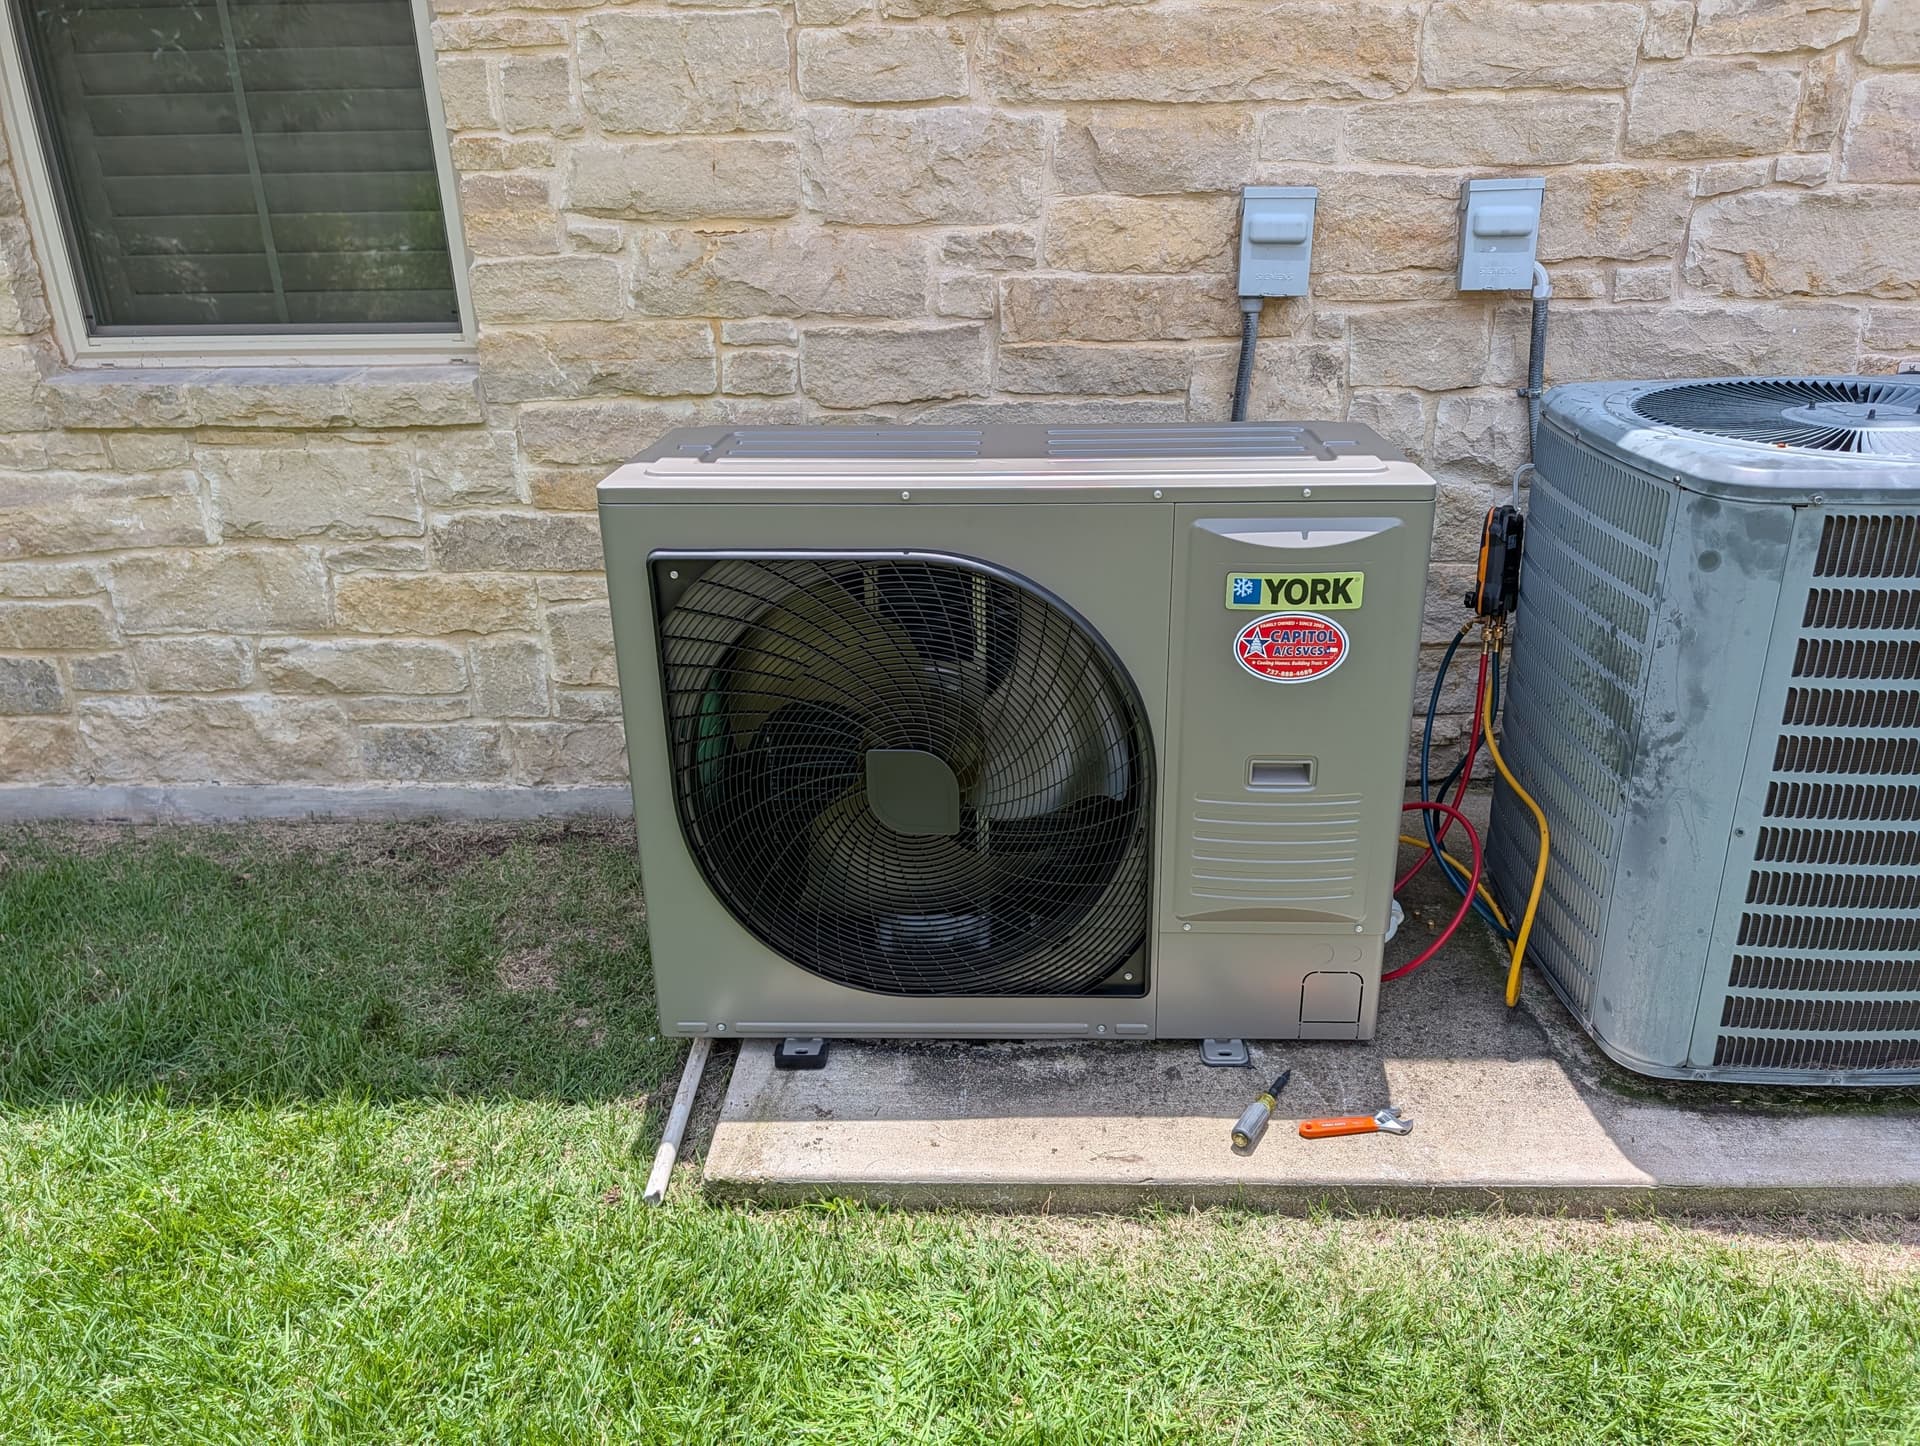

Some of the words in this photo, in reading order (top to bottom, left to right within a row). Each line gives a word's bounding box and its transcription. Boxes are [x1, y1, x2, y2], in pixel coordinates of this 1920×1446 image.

[1264, 577, 1354, 606] YORK
[1270, 629, 1337, 643] CAPITOL
[1273, 646, 1293, 656] A/C
[1295, 645, 1323, 656] SVCS
